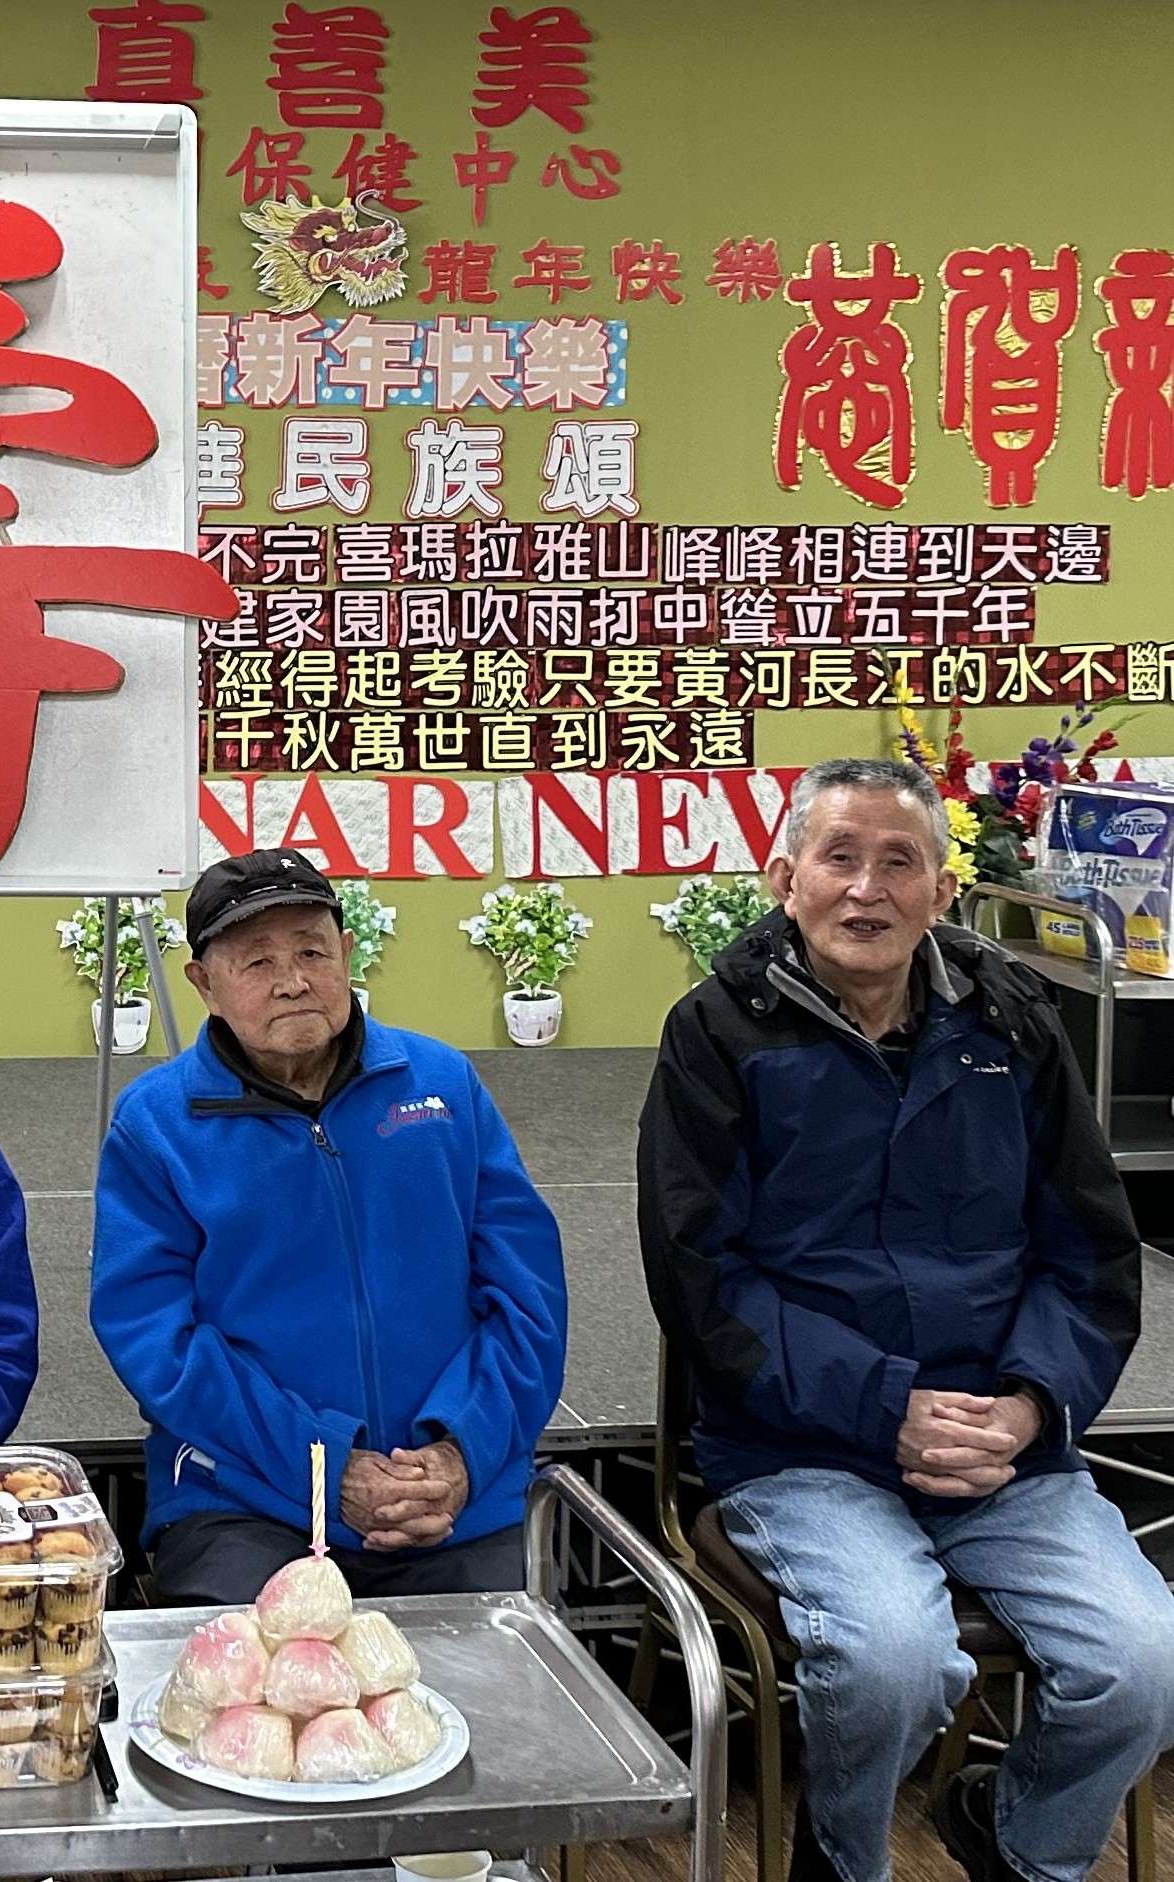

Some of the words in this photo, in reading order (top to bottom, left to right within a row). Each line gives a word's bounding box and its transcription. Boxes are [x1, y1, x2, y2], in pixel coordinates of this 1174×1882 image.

[197, 126, 621, 226] 保健中心
[417, 236, 786, 307] 龍年快樂
[198, 643, 1174, 709] 經得起考驗只要黃河長江的水不斷
